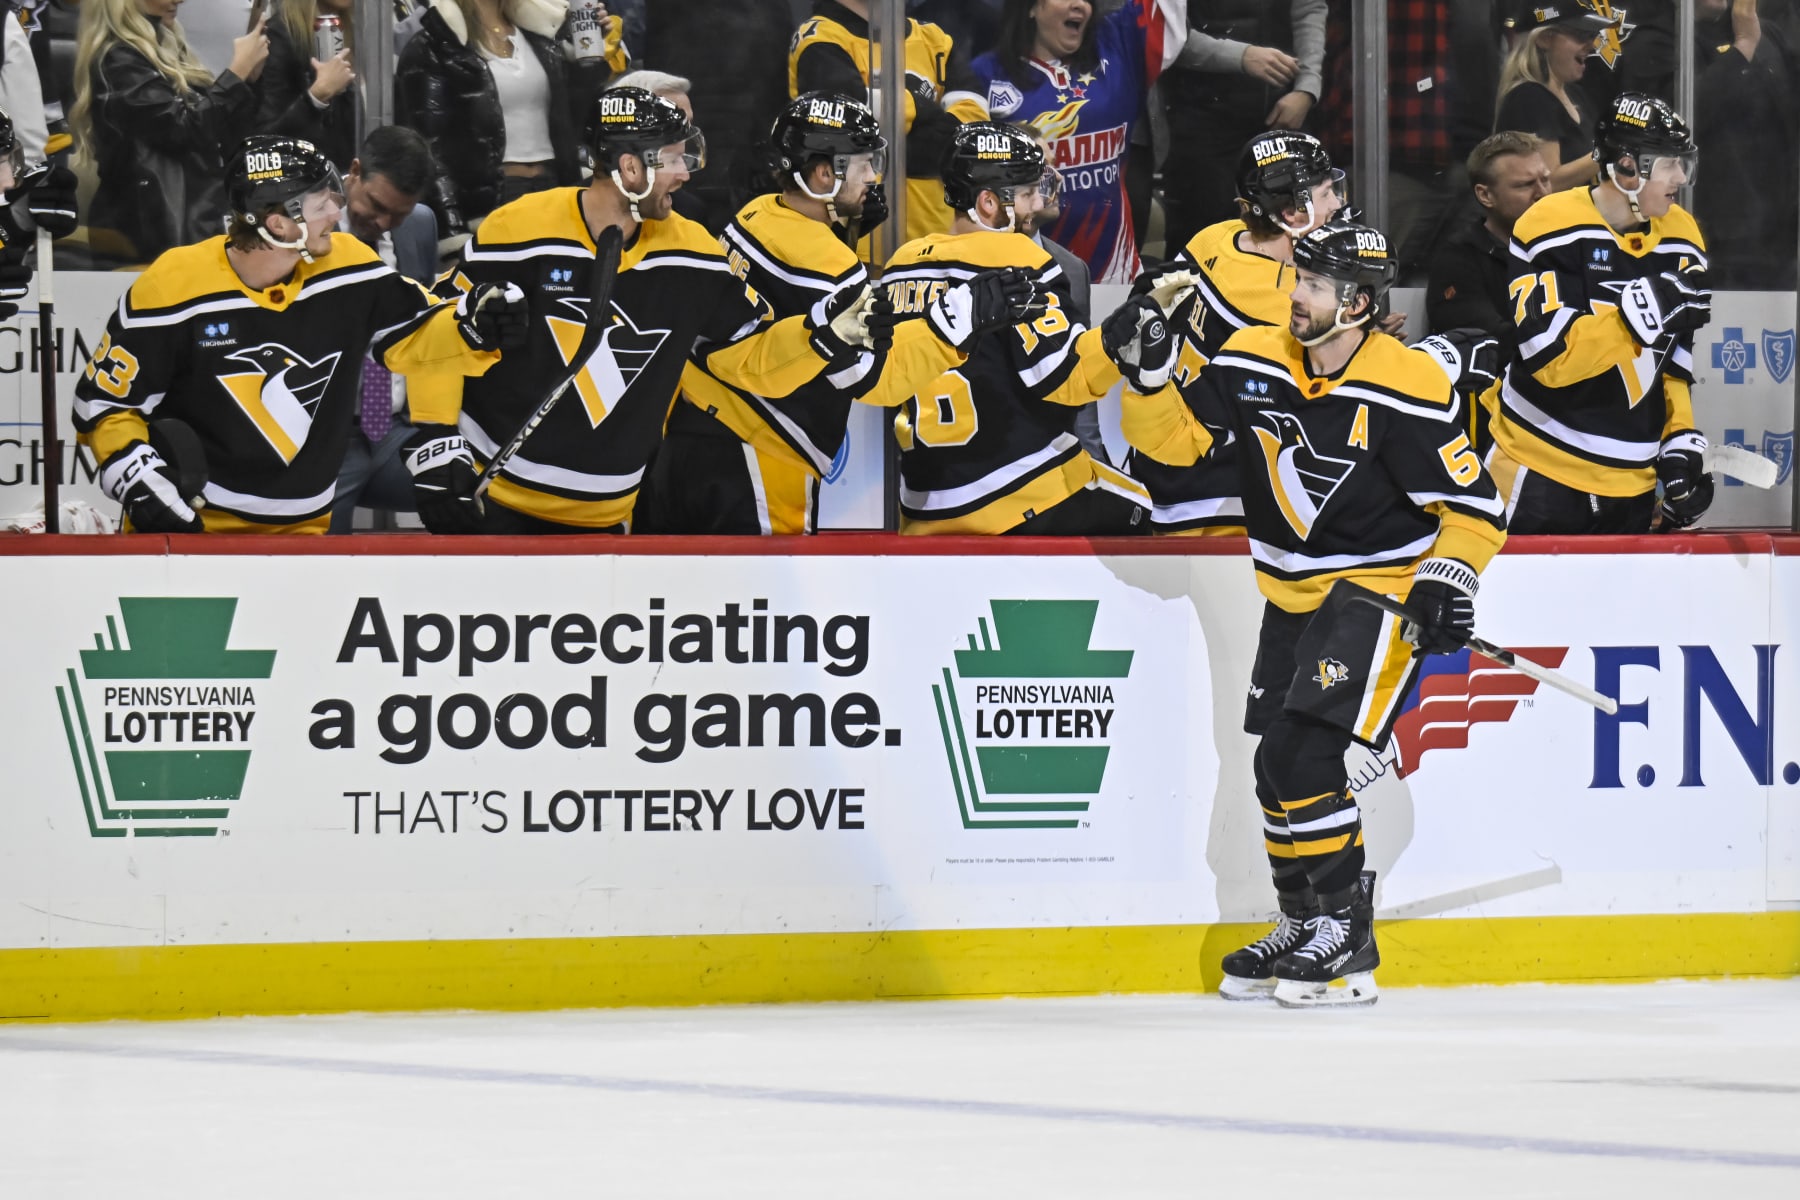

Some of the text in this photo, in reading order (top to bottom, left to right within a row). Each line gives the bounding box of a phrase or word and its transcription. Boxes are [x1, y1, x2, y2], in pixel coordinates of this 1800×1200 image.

[602, 98, 636, 115] BOLD
[810, 99, 844, 121] BOLD
[1618, 97, 1652, 121] BOLD
[808, 117, 842, 128] PENGUIN
[1616, 113, 1648, 128] PENGUIN
[977, 135, 1011, 152] BOLD
[1253, 138, 1287, 161] BOLD
[246, 152, 282, 173] BOLD
[1257, 152, 1289, 167] PENGUIN
[248, 170, 283, 181] PENGUIN
[1355, 232, 1387, 251] BOLD
[1358, 250, 1388, 258] PENGUIN
[1508, 270, 1565, 328] 71
[1347, 404, 1369, 450] A
[112, 450, 161, 499] CCM
[336, 597, 870, 677] Appreciating
[104, 686, 256, 706] PENNSYLVANIA
[976, 685, 1115, 704] PENNSYLVANIA
[104, 711, 256, 743] LOTTERY
[308, 675, 902, 764] a good game.
[976, 708, 1115, 739] LOTTERY
[523, 789, 735, 833] LOTTERY
[747, 788, 865, 831] LOVE
